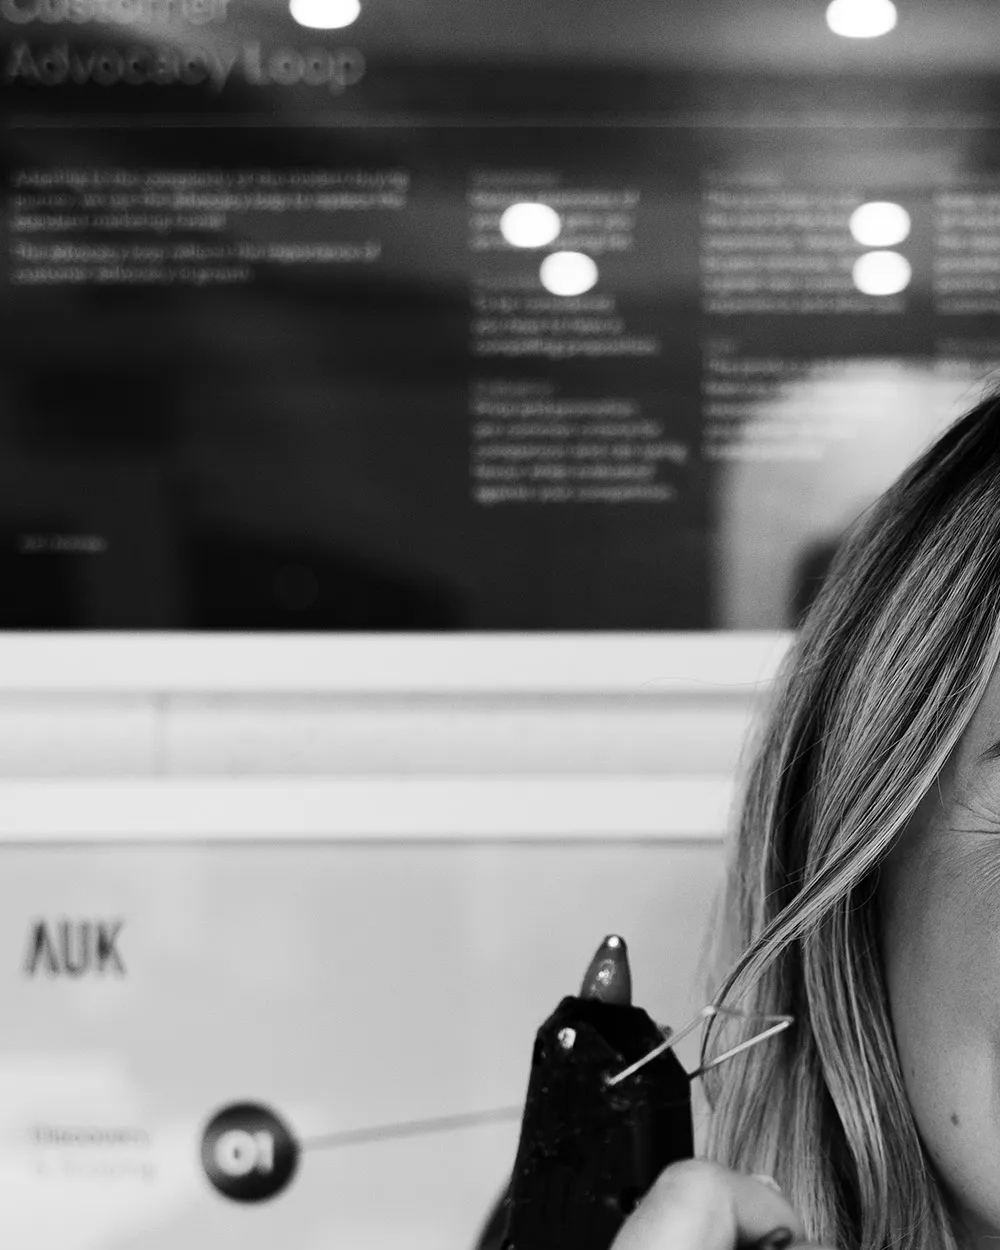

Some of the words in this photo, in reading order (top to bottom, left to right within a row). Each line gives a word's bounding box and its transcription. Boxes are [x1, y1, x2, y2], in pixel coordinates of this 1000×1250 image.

[9, 41, 240, 93] Advocacy
[243, 41, 366, 95] Loop
[25, 919, 127, 979] AUK
[214, 1129, 275, 1177] 01
